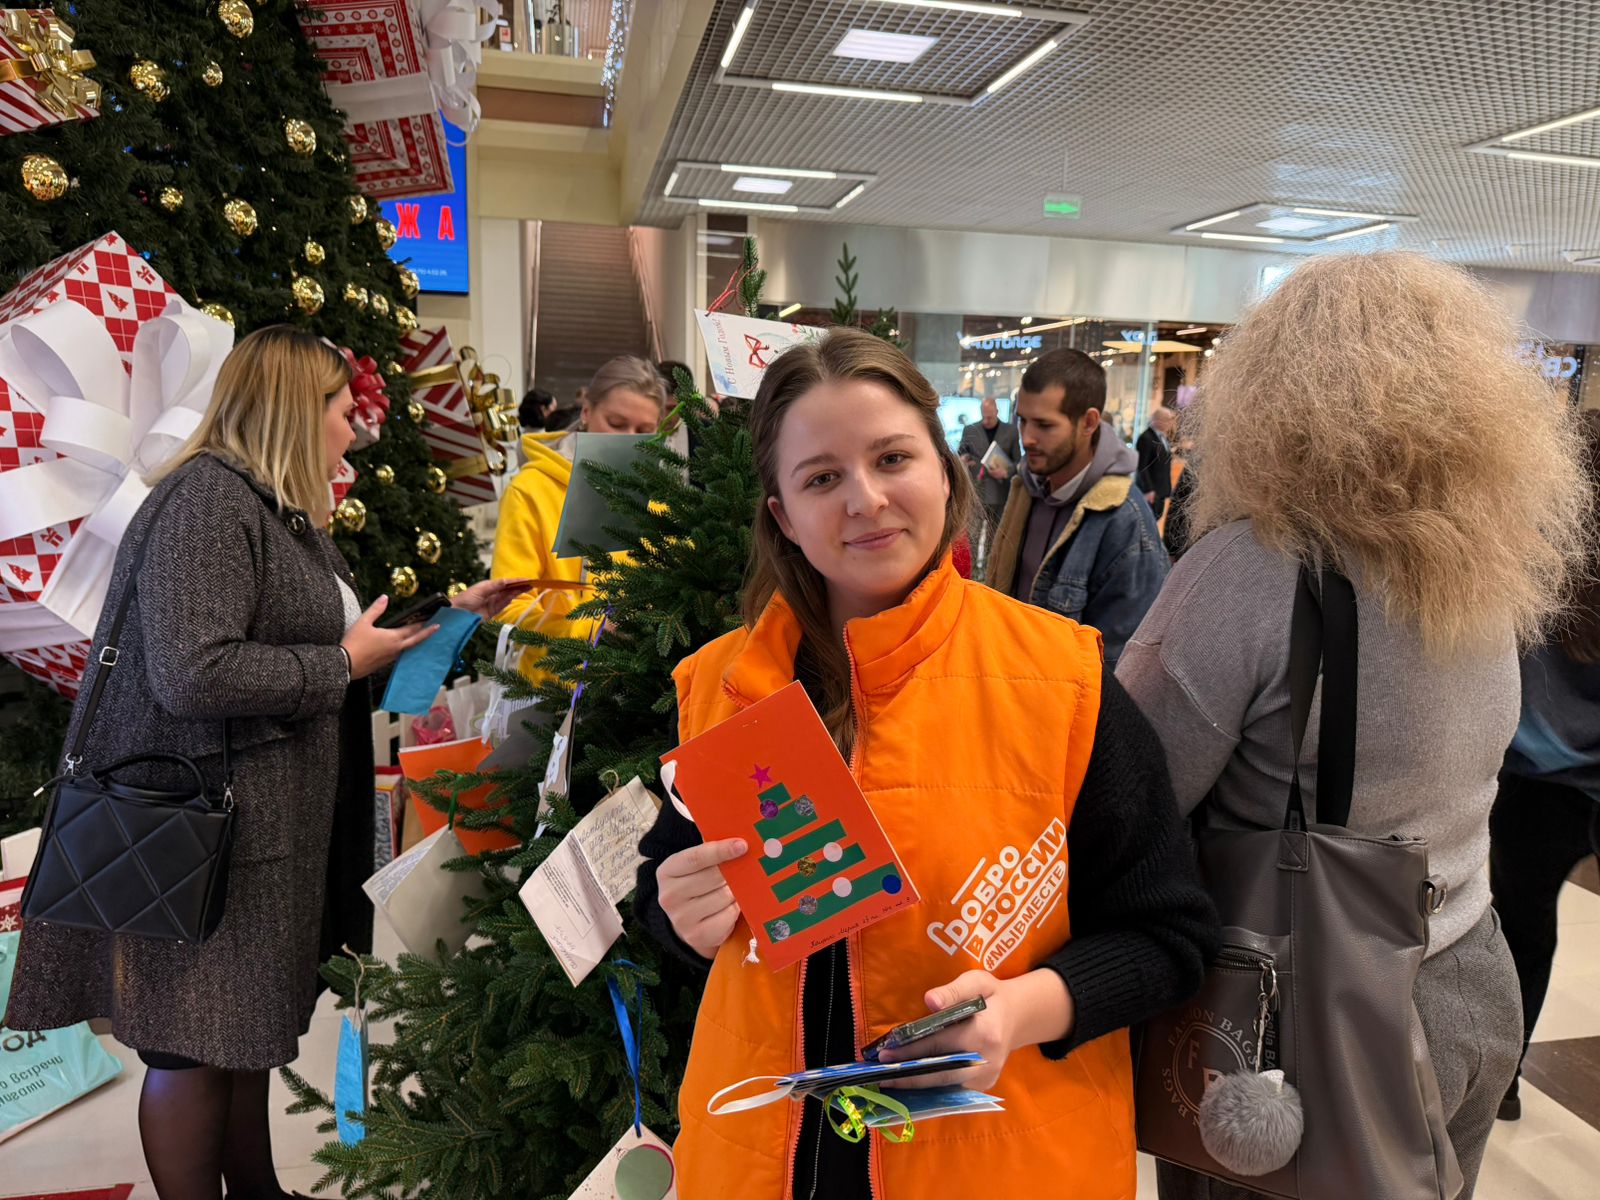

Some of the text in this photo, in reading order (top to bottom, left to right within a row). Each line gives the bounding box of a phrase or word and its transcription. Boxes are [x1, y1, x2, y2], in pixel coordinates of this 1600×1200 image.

[981, 821, 1065, 933] РОССИИ
[986, 865, 1064, 969] #МЫВМЕСТЕ
[10, 1055, 64, 1084] встречи
[1219, 1017, 1257, 1065] BAGS
